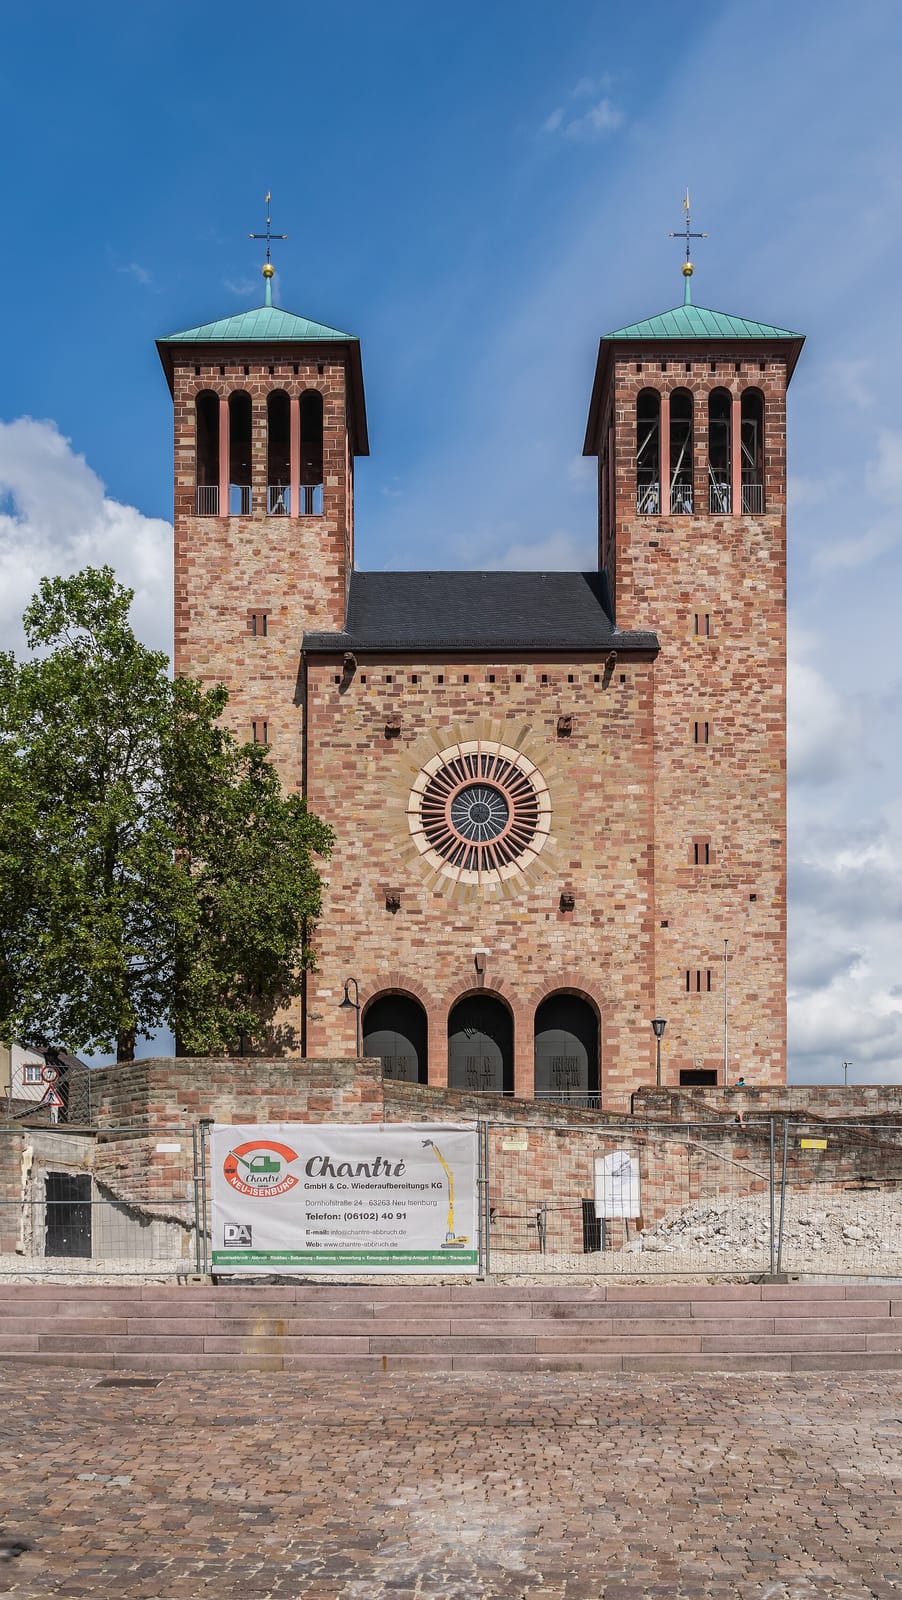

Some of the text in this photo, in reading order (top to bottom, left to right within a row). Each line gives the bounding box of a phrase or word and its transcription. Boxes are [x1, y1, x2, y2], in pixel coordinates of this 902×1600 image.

[305, 1155, 407, 1178] Chantré
[230, 1176, 295, 1197] NEU-ISENBURG
[304, 1182, 327, 1190] GmbH
[351, 1182, 430, 1191] Wiederaufbereitungs
[431, 1182, 443, 1190] KG
[408, 1200, 438, 1208] Isenburg
[305, 1212, 407, 1222] Telefon: (06102) 40 91
